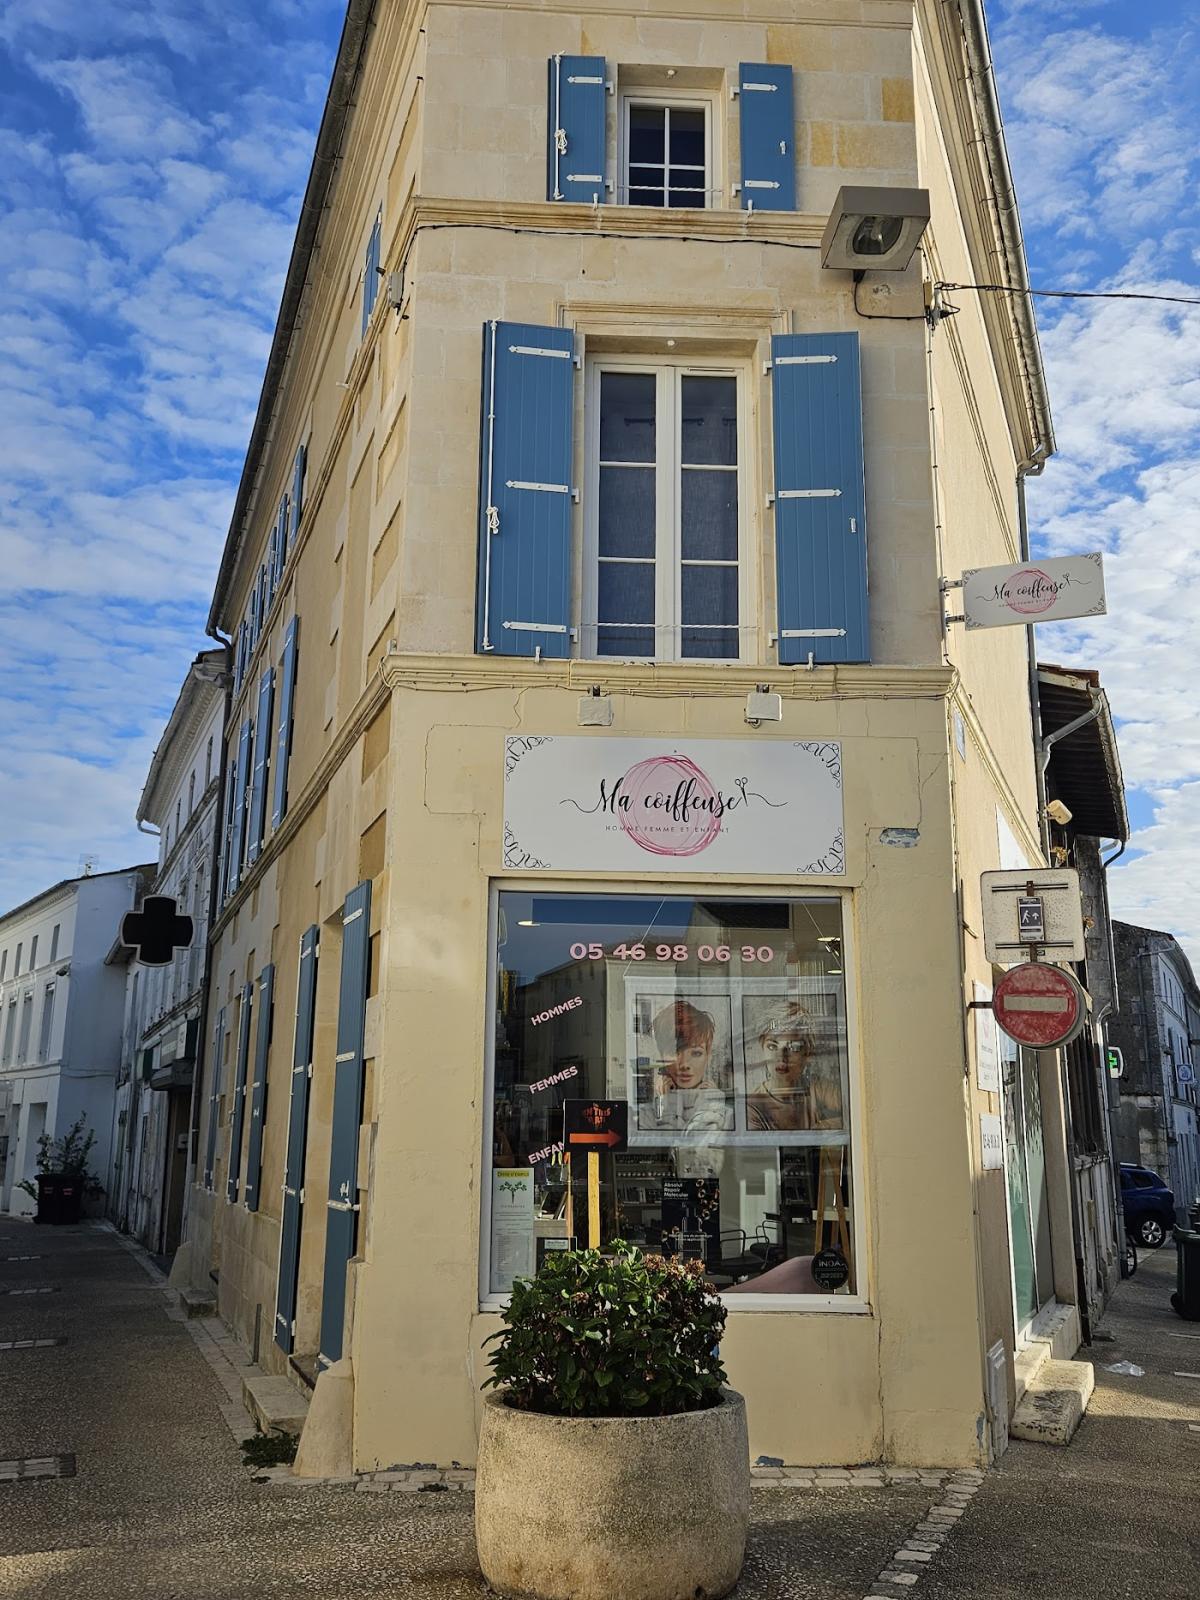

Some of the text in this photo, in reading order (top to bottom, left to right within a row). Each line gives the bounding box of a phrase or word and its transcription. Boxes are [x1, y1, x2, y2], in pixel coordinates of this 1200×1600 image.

[995, 577, 1066, 600] Ma coiffeuse
[599, 776, 743, 823] Ma coiffeuse
[569, 942, 774, 963] 05 46 98 06 30
[531, 996, 584, 1026] HOMMES
[529, 1065, 579, 1094] FEMMES
[528, 1141, 565, 1165] ENFAN
